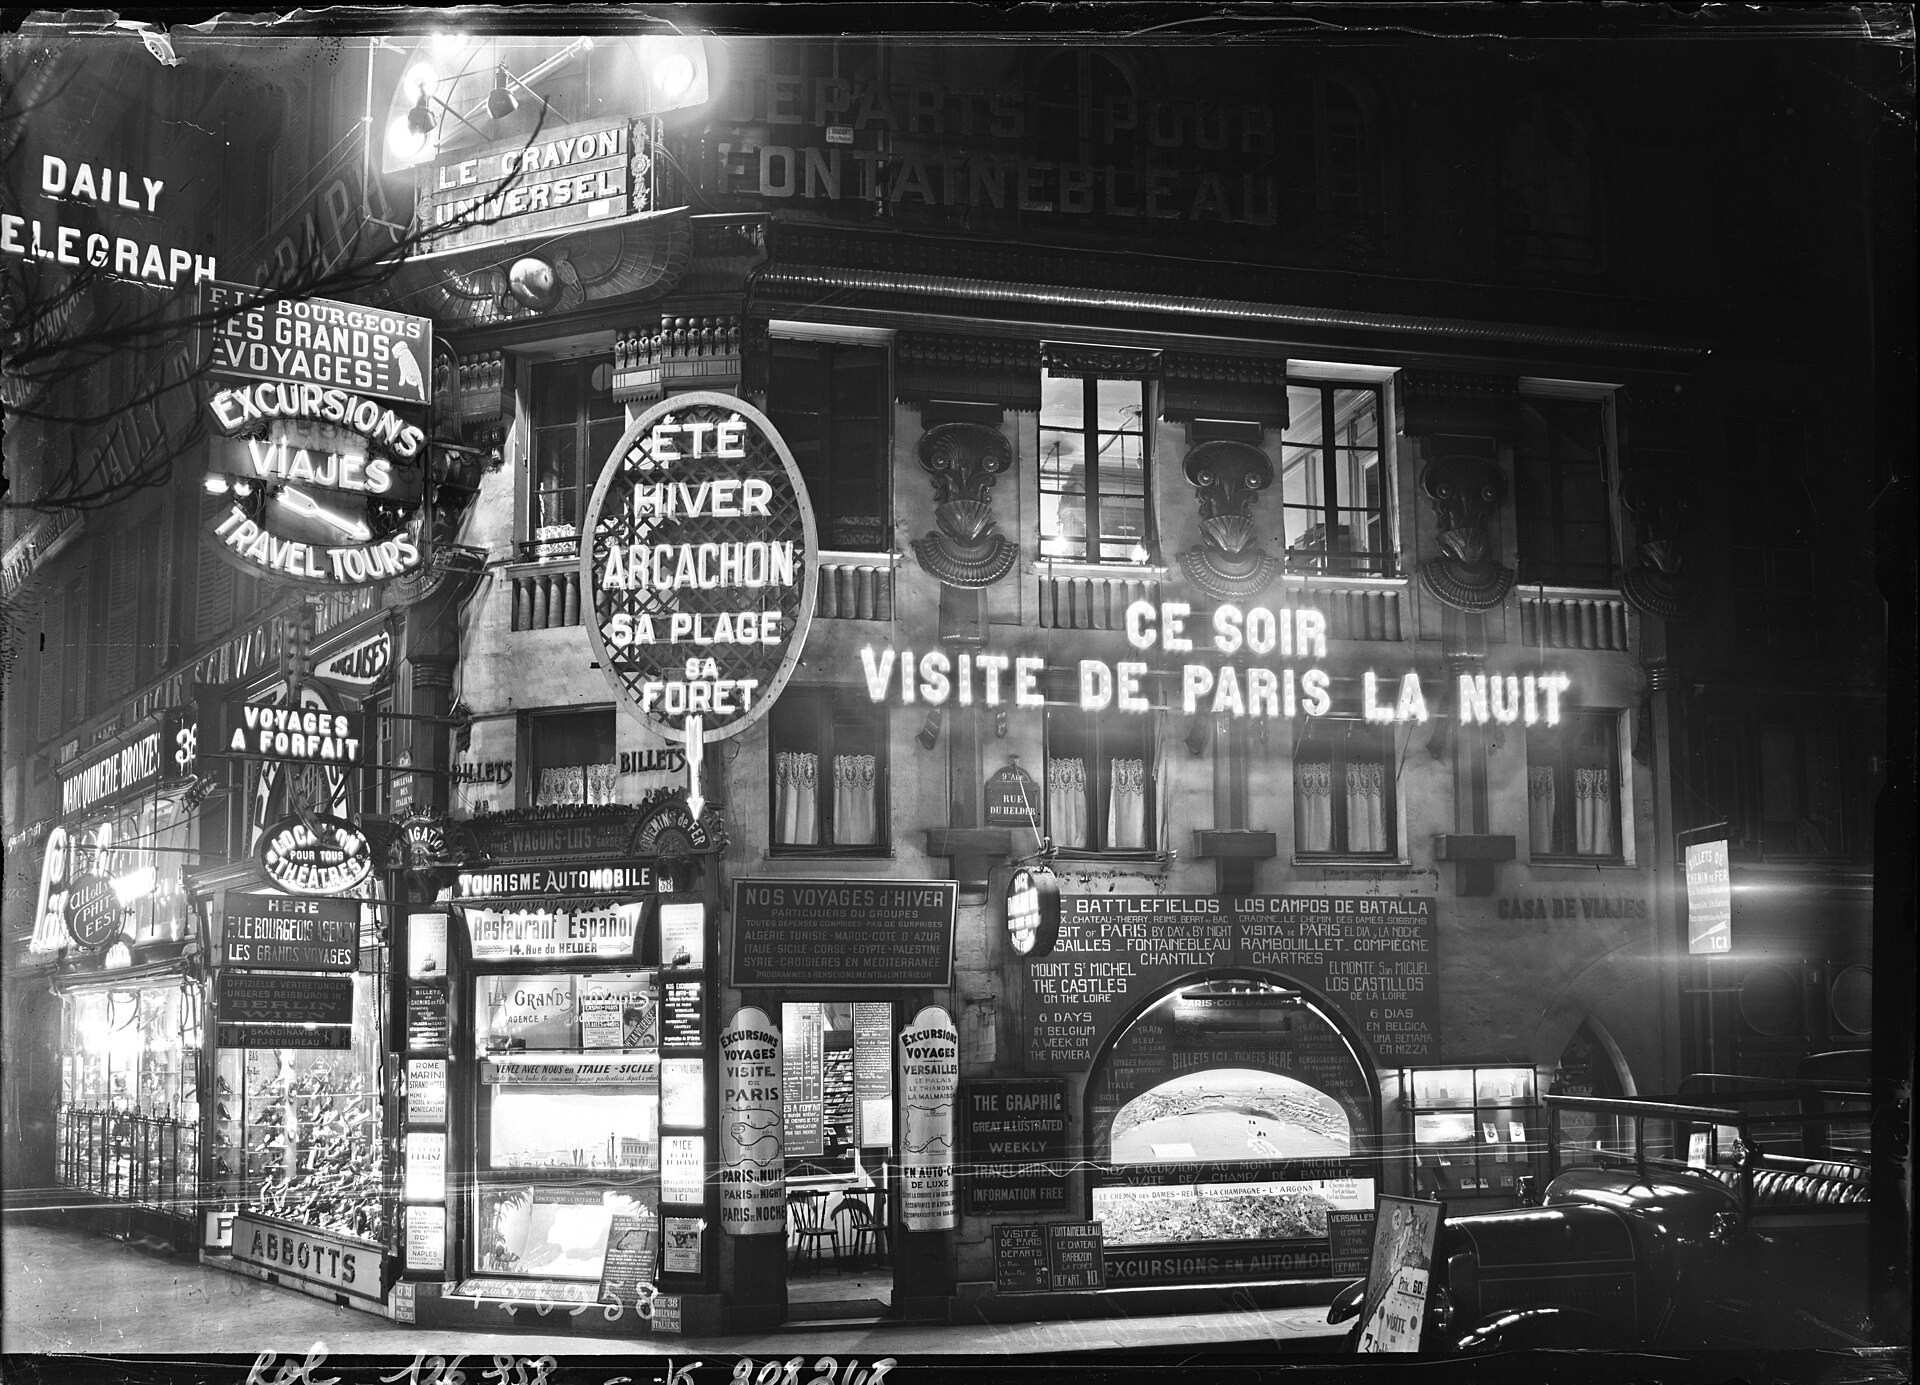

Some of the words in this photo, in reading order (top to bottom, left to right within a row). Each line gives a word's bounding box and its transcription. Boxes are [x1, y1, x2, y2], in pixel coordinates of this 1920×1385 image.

[1104, 96, 1275, 154] POUR
[439, 159, 478, 190] LE
[502, 130, 620, 174] CRAYON
[42, 155, 164, 213] DAILY
[717, 142, 1278, 225] FONTAINEBLEAU
[437, 172, 619, 226] UNIVERSEL
[276, 300, 421, 339] BOURGEOIS
[275, 317, 390, 362] GRANDS
[225, 339, 372, 388] VOYAGES
[209, 381, 425, 457] EXCURSIONS
[651, 413, 746, 459] ÉTÉ
[248, 436, 392, 493] VIAJES
[634, 479, 774, 517] HIVER
[214, 507, 326, 578] TRAVEL
[327, 533, 421, 583] TOURS
[602, 541, 794, 590] ARCACHON
[611, 613, 656, 646] SA
[671, 611, 782, 644] PLAGE
[1126, 600, 1193, 651] CE
[1214, 606, 1328, 657] SOIR
[686, 657, 719, 679] SA
[861, 646, 1046, 706] VISITE
[1079, 658, 1149, 710] DE
[1183, 664, 1332, 718] PARIS
[1362, 670, 1429, 723] LA
[1459, 672, 1570, 725] NUIT
[643, 680, 758, 714] FORET
[244, 707, 349, 738] VOYAGES
[231, 729, 246, 750] A
[260, 731, 359, 760] FORFAIT
[619, 747, 687, 773] BILLETS
[453, 760, 513, 784] BILLETS
[1003, 795, 1024, 803] RUE
[1004, 807, 1036, 815] HELDER
[688, 820, 705, 846] FER
[290, 850, 315, 860] POUR
[320, 851, 344, 861] TOUS
[1689, 850, 1712, 870] BILLETS
[276, 857, 362, 889] THÉÂTRES
[459, 873, 541, 897] TOURISME
[544, 868, 650, 892] AUTOMOBILE
[746, 889, 784, 905] NOS
[793, 889, 874, 907] VOYAGES
[268, 900, 319, 914] HERE
[1077, 899, 1219, 913] BATTLEFIELDS
[1235, 899, 1264, 912] LOS
[1271, 899, 1329, 913] CAMPOS
[1335, 900, 1354, 913] DE
[1360, 900, 1428, 914] BATALLA
[1499, 899, 1547, 919] CASA
[1552, 899, 1576, 918] DE
[1583, 899, 1646, 918] VIAJES
[772, 909, 847, 918] PARTICULIERS
[851, 910, 865, 918] OU
[869, 910, 919, 919] GROUPES
[254, 918, 313, 941] BOURGEOIS
[474, 915, 556, 941] Restaurant
[568, 912, 633, 937] Español
[1101, 925, 1146, 937] PARIS
[1152, 926, 1165, 937] BY
[1168, 926, 1184, 937] DAY
[1193, 926, 1205, 937] BY
[1207, 926, 1232, 937] NIGHT
[1242, 925, 1283, 935] VISITA
[1300, 924, 1340, 936] PARIS
[790, 931, 827, 941] TUNISIE
[526, 945, 542, 954] Rue
[545, 944, 556, 954] du
[559, 943, 597, 953] HELDER
[1127, 939, 1231, 951] FONTAINEBLEAU
[1241, 938, 1344, 950] RAMBOUILLET
[229, 944, 250, 961] LES
[257, 946, 299, 962] GRANDS
[304, 949, 351, 965] VOYAGES
[1141, 953, 1215, 965] CHANTILLY
[1253, 952, 1323, 964] CHARTRES
[1031, 963, 1070, 977] MOUNT
[1090, 963, 1136, 976] MICHEL
[1340, 962, 1374, 974] MONTE
[1396, 962, 1431, 975] MIGUEL
[1033, 980, 1056, 993] THE
[1062, 979, 1127, 993] CASTLES
[1326, 977, 1348, 991] LOS
[1354, 977, 1424, 991] CASTILLOS
[515, 988, 573, 1012] GRANDS
[1044, 995, 1058, 1003] ON
[1061, 995, 1079, 1003] THE
[1084, 994, 1111, 1003] LOIRE
[1383, 992, 1407, 1000] LOIRE
[508, 1014, 540, 1024] AGENCE
[1055, 1013, 1092, 1022] DAYS
[1385, 1009, 1413, 1018] DIAS
[251, 1028, 320, 1037] SKANDINAVISK
[1048, 1026, 1095, 1036] BELGIUM
[1386, 1022, 1427, 1031] BELGICA
[251, 1038, 320, 1046] REJSEBUREAU
[720, 1030, 778, 1049] EXCURSIONS
[901, 1029, 957, 1047] EXCURSIONS
[1044, 1038, 1072, 1047] WEEK
[1374, 1034, 1390, 1043] UNA
[1395, 1034, 1432, 1043] SEMANA
[724, 1049, 776, 1061] VOYAGES
[906, 1048, 955, 1059] VOYAGES
[1031, 1051, 1048, 1060] THE
[1052, 1050, 1090, 1060] RIVIERA
[1380, 1045, 1393, 1054] EN
[1396, 1045, 1427, 1054] NIZZA
[1173, 1052, 1209, 1070] BILLETS
[1234, 1052, 1266, 1065] TICKETS
[1269, 1052, 1292, 1070] HERE
[411, 1071, 444, 1079] MARINI
[496, 1064, 520, 1074] VENEZ
[522, 1064, 540, 1074] AVEC
[542, 1065, 562, 1074] NOUS
[577, 1064, 611, 1074] ITALIE
[727, 1066, 775, 1077] VISITE
[903, 1065, 957, 1075] VERSAILLES
[725, 1088, 779, 1101] PARIS
[974, 1095, 998, 1111] THE
[1006, 1094, 1061, 1111] GRAPHIC
[972, 1122, 1000, 1133] GREAT
[1003, 1120, 1063, 1132] ILLUSTRATED
[673, 1140, 692, 1150] NICE
[989, 1141, 1047, 1153] WEEKLY
[904, 1167, 916, 1178] EN
[974, 1165, 1013, 1178] TRAVEL
[1135, 1162, 1204, 1175] EXCURSIONS
[1302, 1158, 1345, 1168] MICHEL
[723, 1170, 752, 1183] PARIS
[1127, 1174, 1165, 1186] VISITE
[1212, 1172, 1257, 1182] CHAMPS
[1272, 1171, 1287, 1180] DE
[1301, 1169, 1352, 1180] BATAILLE
[724, 1189, 752, 1199] PARIS
[973, 1188, 1036, 1201] INFORMATION
[1039, 1187, 1063, 1199] FREE
[1152, 1190, 1175, 1198] DAMES
[1220, 1187, 1260, 1196] CHAMPAGNE
[723, 1208, 750, 1222] PARIS
[756, 1205, 786, 1221] NOCHE
[1331, 1213, 1374, 1222] VERSAILLES
[1003, 1229, 1038, 1238] VISITE
[1050, 1226, 1099, 1237] FONTAINEBLEAU
[1016, 1237, 1041, 1246] PARIS
[251, 1229, 356, 1283] ABBOTTS
[1105, 1258, 1218, 1278] EXCURSIONS
